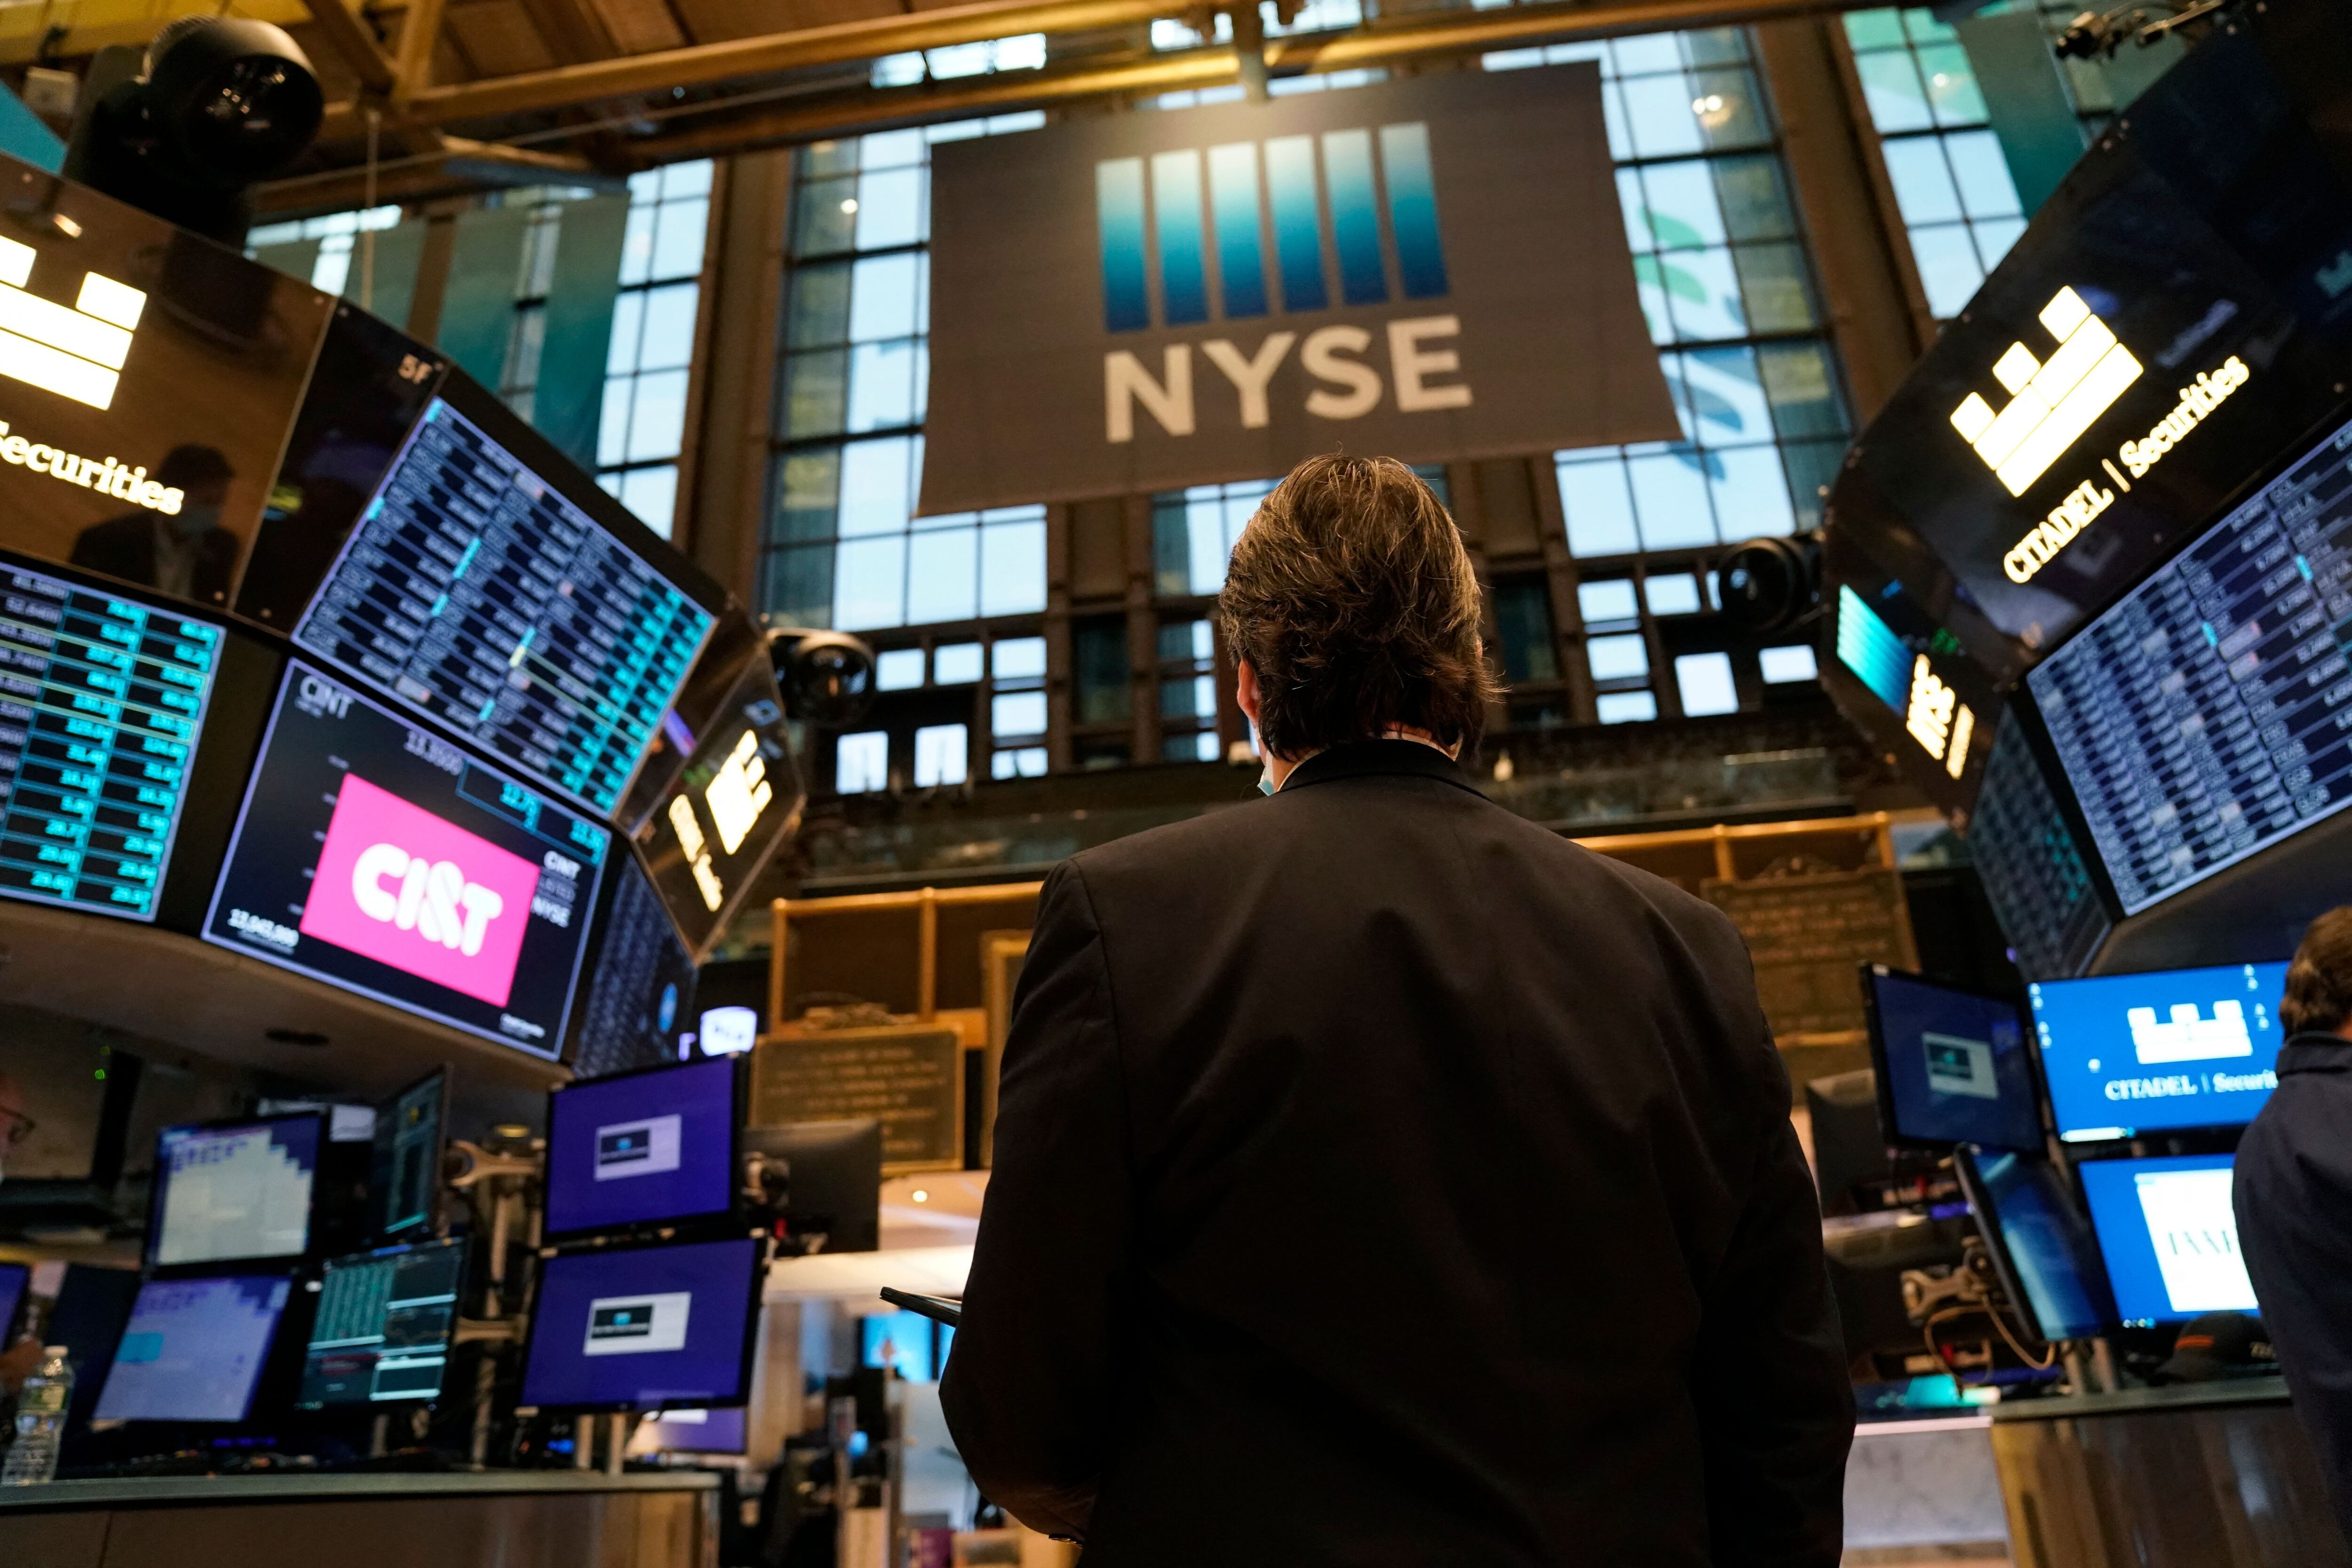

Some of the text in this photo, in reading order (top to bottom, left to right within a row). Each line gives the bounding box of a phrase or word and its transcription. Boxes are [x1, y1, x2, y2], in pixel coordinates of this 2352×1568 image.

[1104, 314, 1474, 443] NYSE
[2003, 479, 2115, 584] CITADEL
[2119, 355, 2250, 479] Securities
[351, 843, 503, 957] CI&T
[2105, 1075, 2198, 1101] CITADEL
